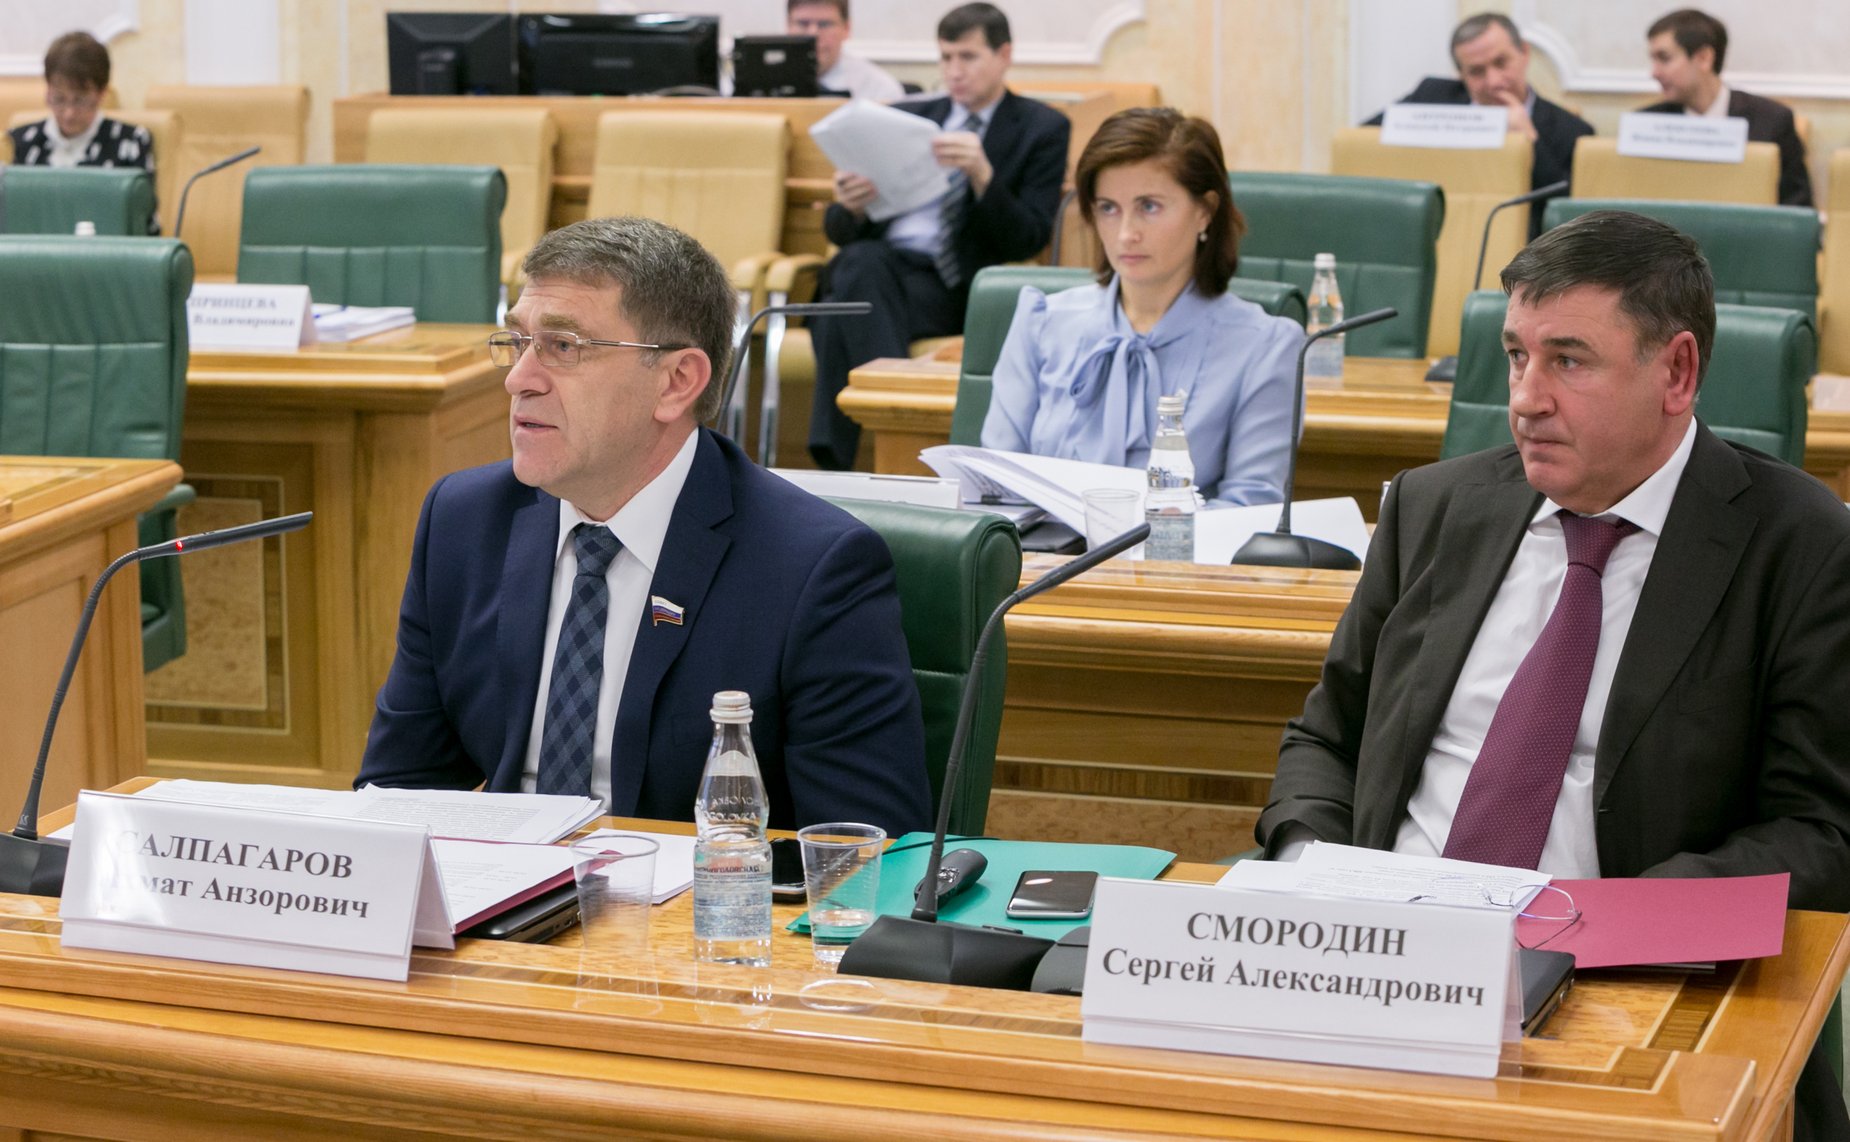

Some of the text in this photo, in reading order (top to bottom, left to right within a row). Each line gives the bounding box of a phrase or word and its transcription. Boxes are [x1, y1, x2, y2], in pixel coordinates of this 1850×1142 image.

[107, 864, 371, 919] мат Анзорович
[1186, 911, 1409, 957] СМОРОДИН
[1102, 946, 1486, 1007] Сергей Александрович
